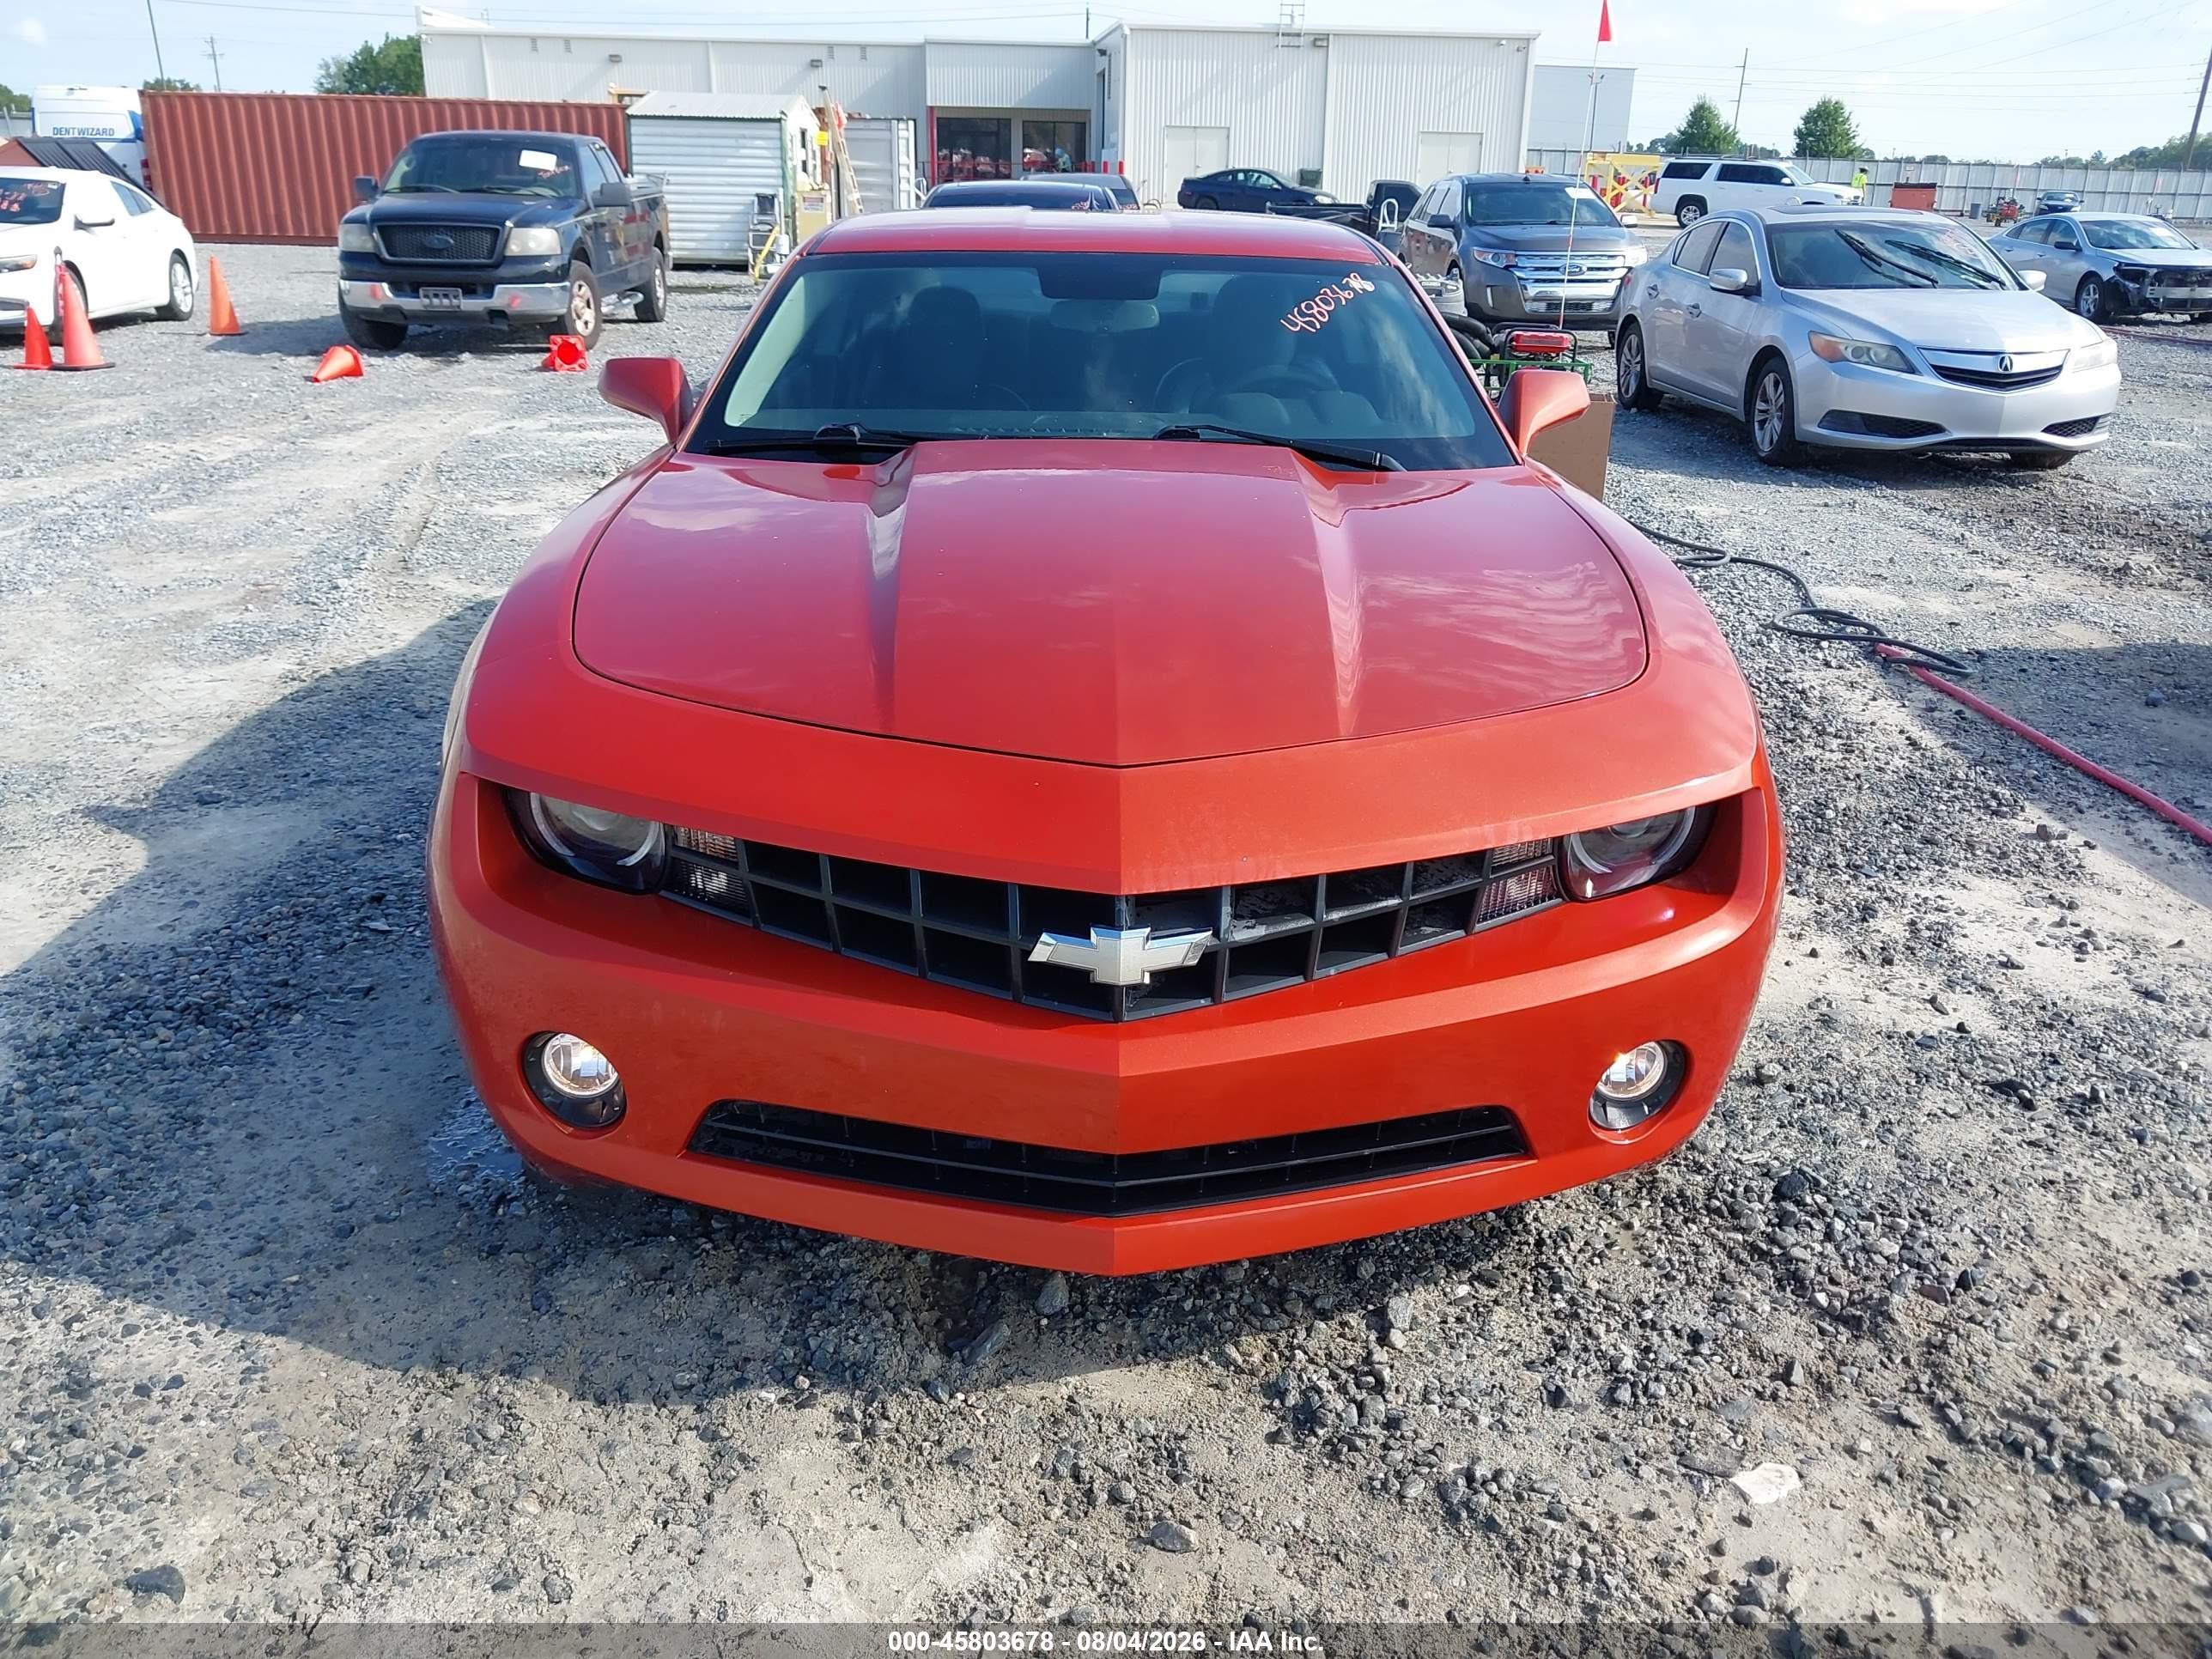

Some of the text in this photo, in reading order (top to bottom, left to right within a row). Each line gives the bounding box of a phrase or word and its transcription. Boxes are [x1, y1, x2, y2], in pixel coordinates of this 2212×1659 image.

[52, 126, 115, 137] DENT WIZARD
[1279, 272, 1376, 332] 45803678
